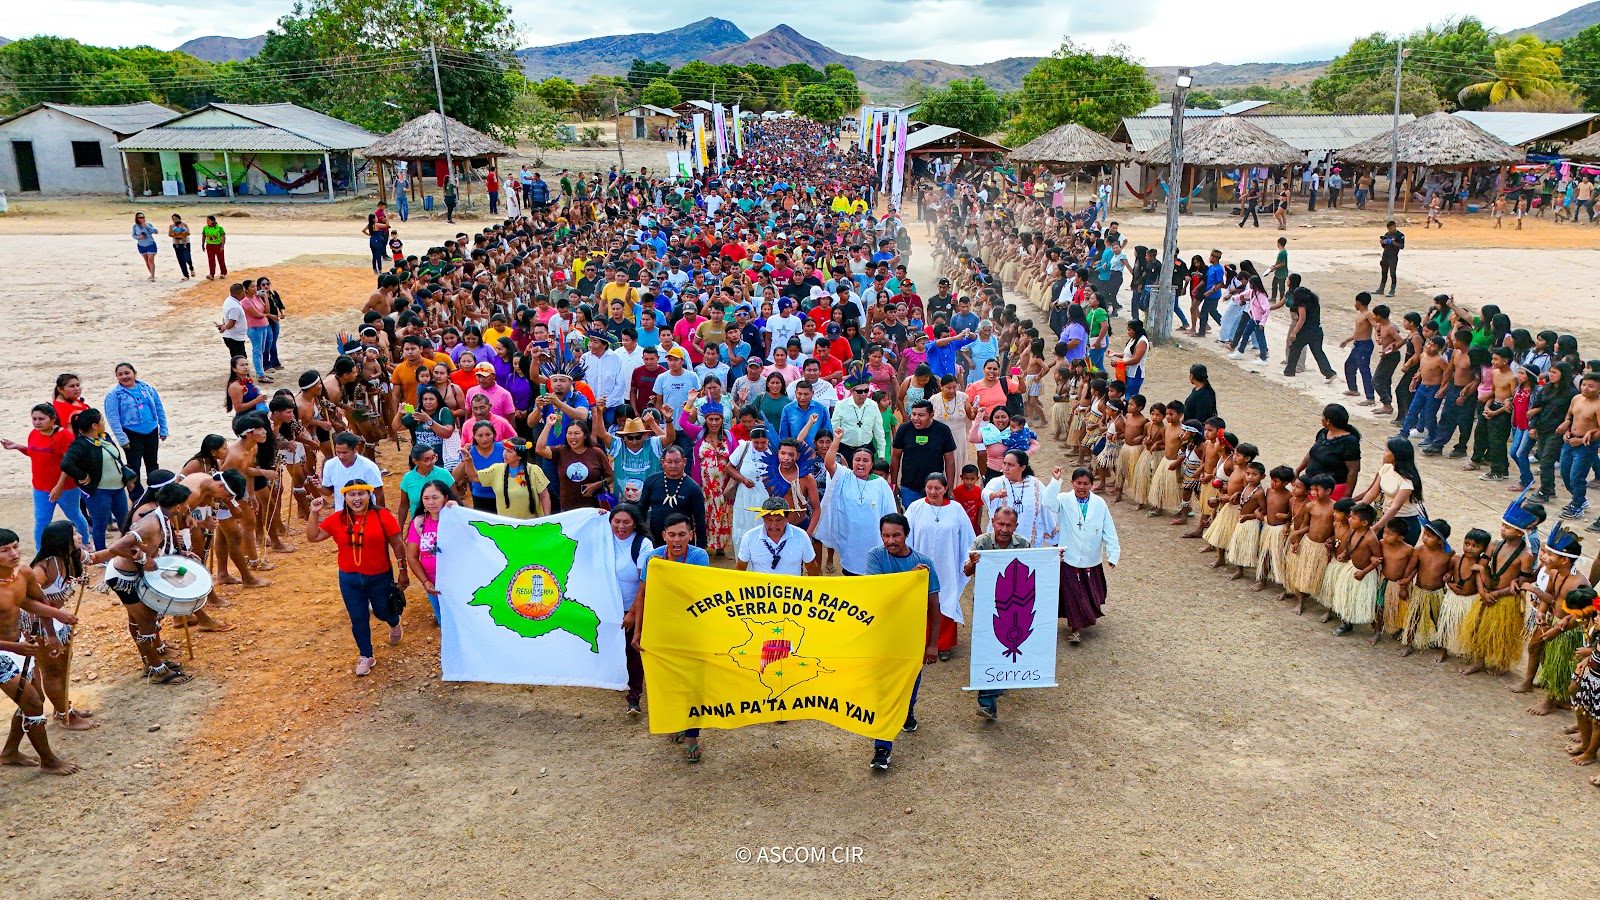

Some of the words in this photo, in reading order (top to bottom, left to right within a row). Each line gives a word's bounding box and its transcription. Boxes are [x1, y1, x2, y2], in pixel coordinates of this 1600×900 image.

[686, 590, 736, 618] TERRA
[739, 582, 813, 603] INDÍGENA
[818, 592, 876, 626] RAPOSA
[725, 601, 778, 618] SERRA
[782, 602, 803, 616] DO
[807, 606, 836, 623] SOL
[984, 667, 1041, 683] Serras
[688, 702, 736, 718] ANNA
[740, 698, 787, 714] PA'TA
[791, 695, 839, 713] ANNA
[844, 701, 876, 725] YAN
